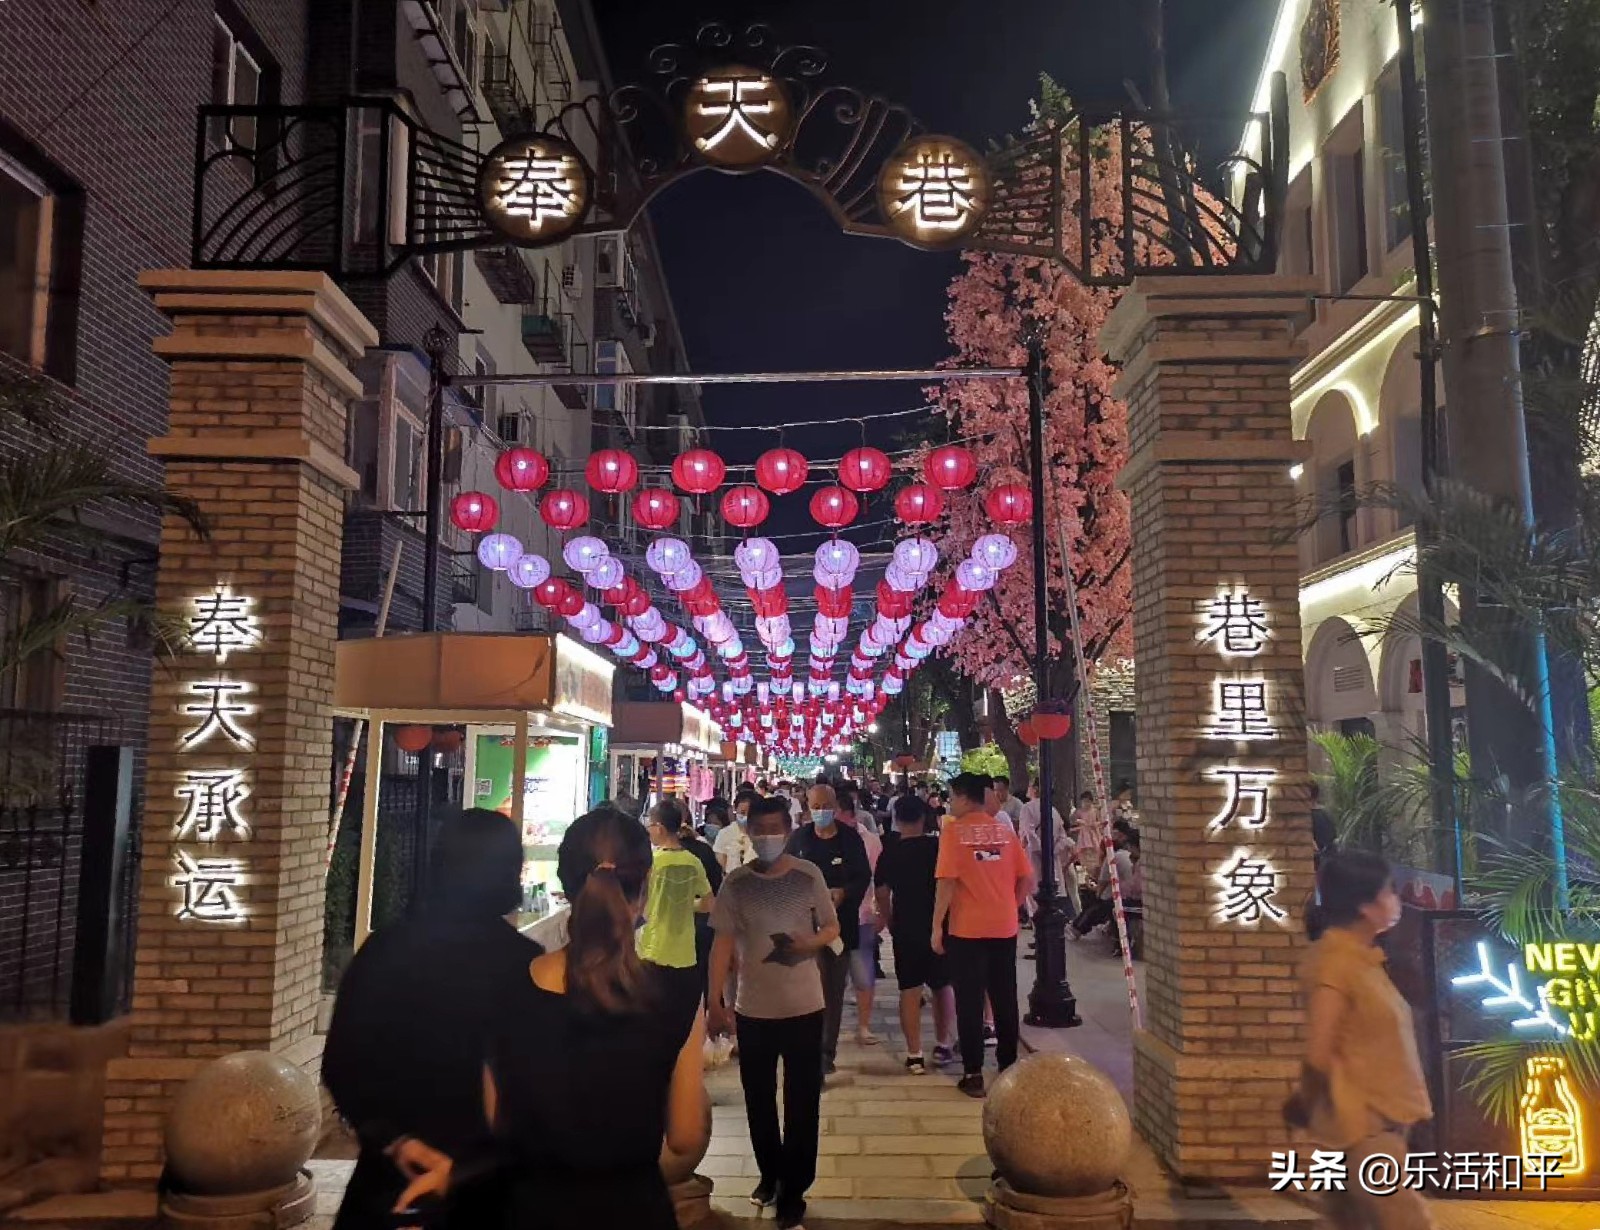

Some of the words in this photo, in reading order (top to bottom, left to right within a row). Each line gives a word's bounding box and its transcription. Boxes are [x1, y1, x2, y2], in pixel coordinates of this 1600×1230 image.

[495, 75, 976, 229] 奉天巷
[174, 588, 259, 921] 奉天承运
[1203, 589, 1284, 922] 巷里万象
